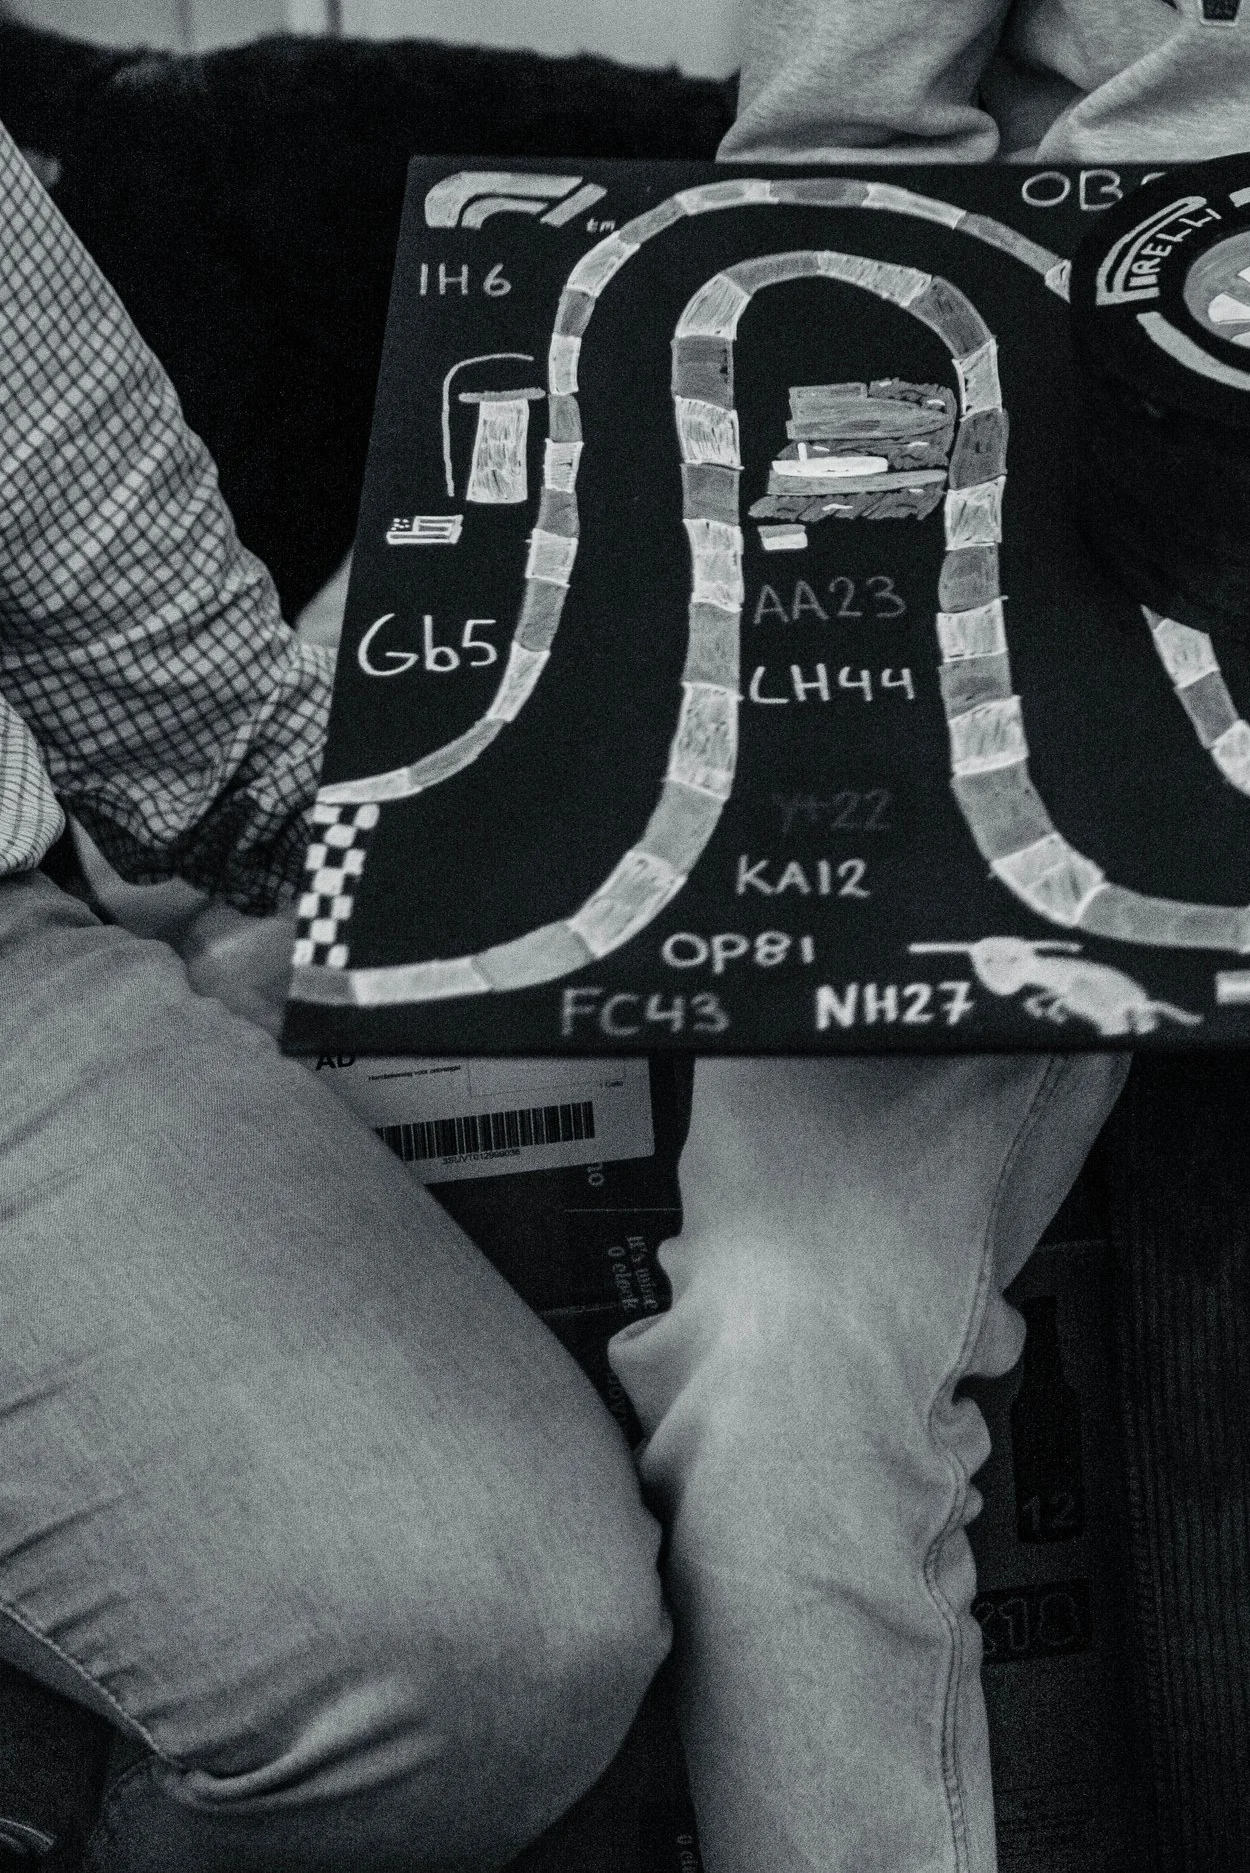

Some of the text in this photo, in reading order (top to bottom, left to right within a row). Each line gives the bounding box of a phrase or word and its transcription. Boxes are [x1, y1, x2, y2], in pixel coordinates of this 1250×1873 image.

[1021, 168, 1166, 212] OB
[753, 576, 907, 625] AA23
[749, 663, 915, 704] LH44
[736, 855, 870, 899] KA12
[660, 930, 815, 976] OP81
[560, 986, 730, 1037] FC43
[815, 980, 975, 1030] NH27
